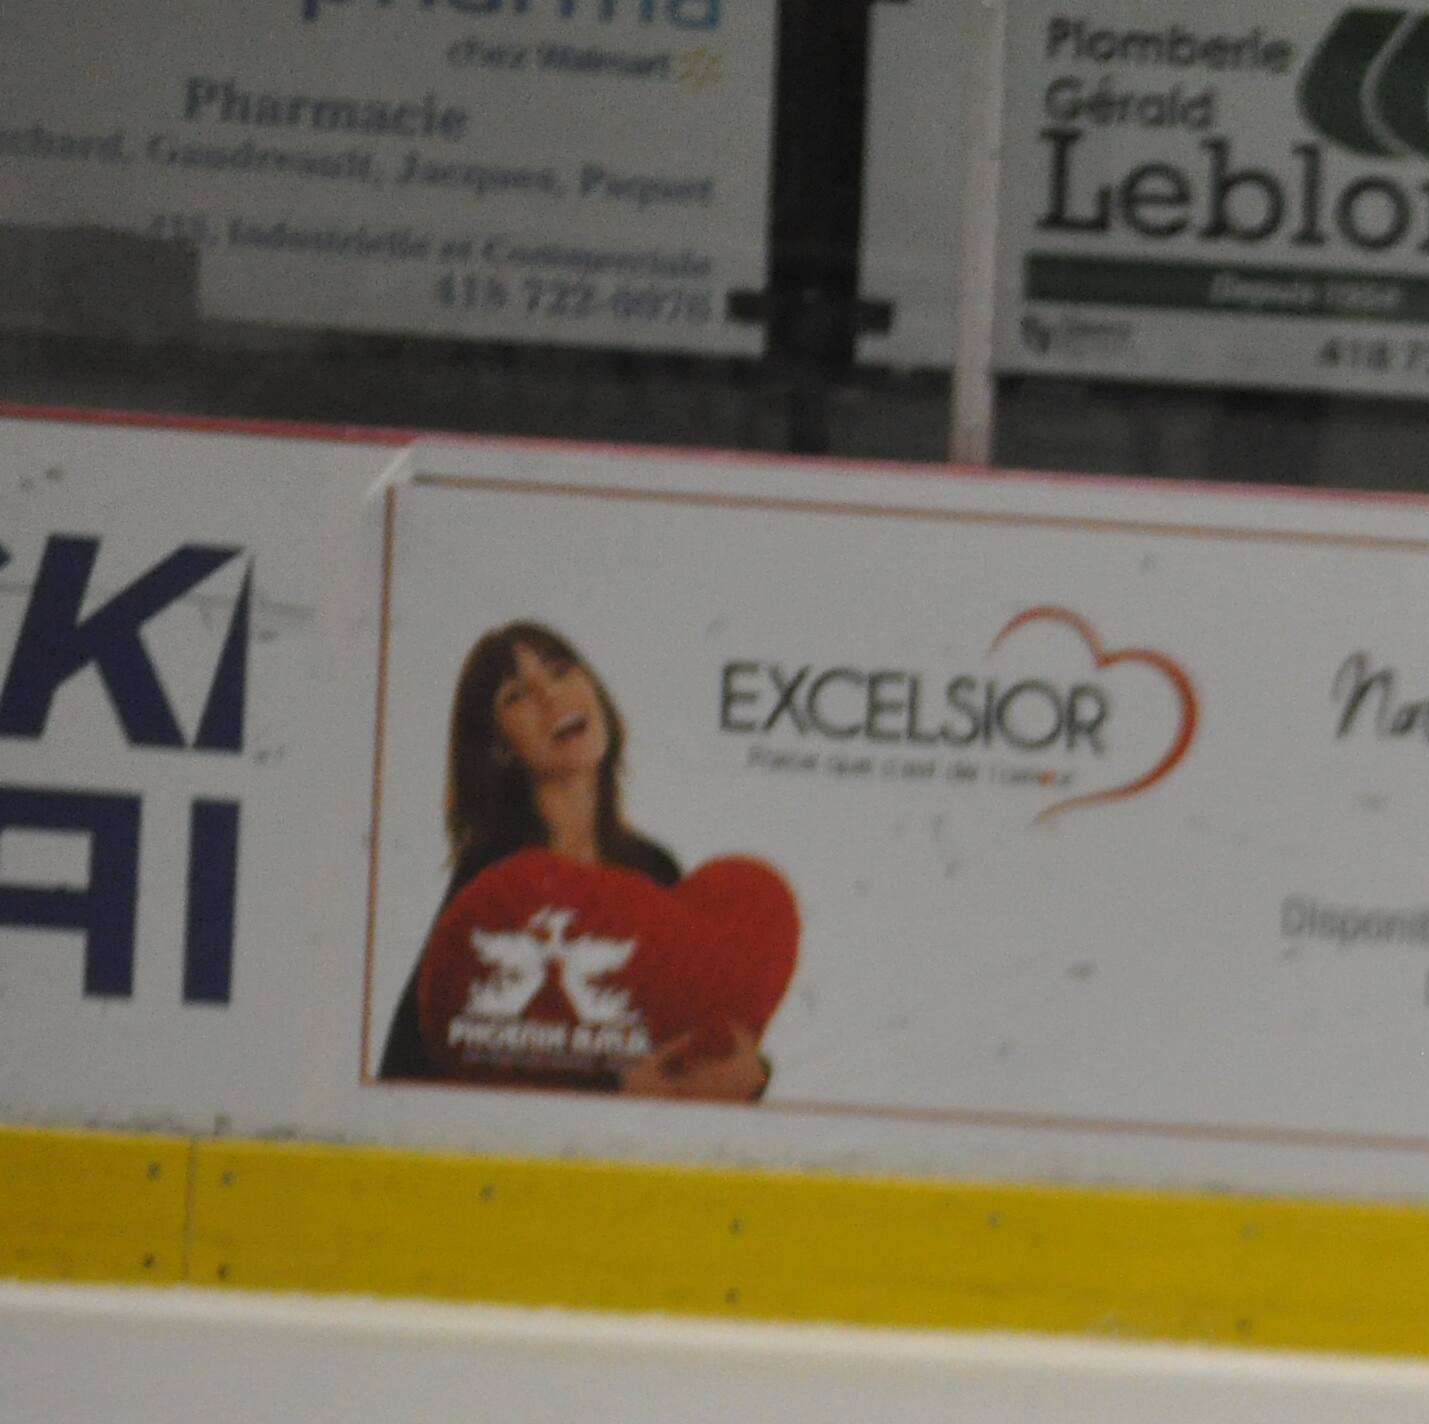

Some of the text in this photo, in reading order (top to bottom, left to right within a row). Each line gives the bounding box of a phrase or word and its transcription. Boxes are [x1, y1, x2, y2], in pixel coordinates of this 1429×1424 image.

[1044, 18, 1292, 73] Plomberie
[184, 76, 469, 142] Pharmacie
[1044, 77, 1217, 131] Gérald
[716, 658, 1114, 757] EXCELSIOR
